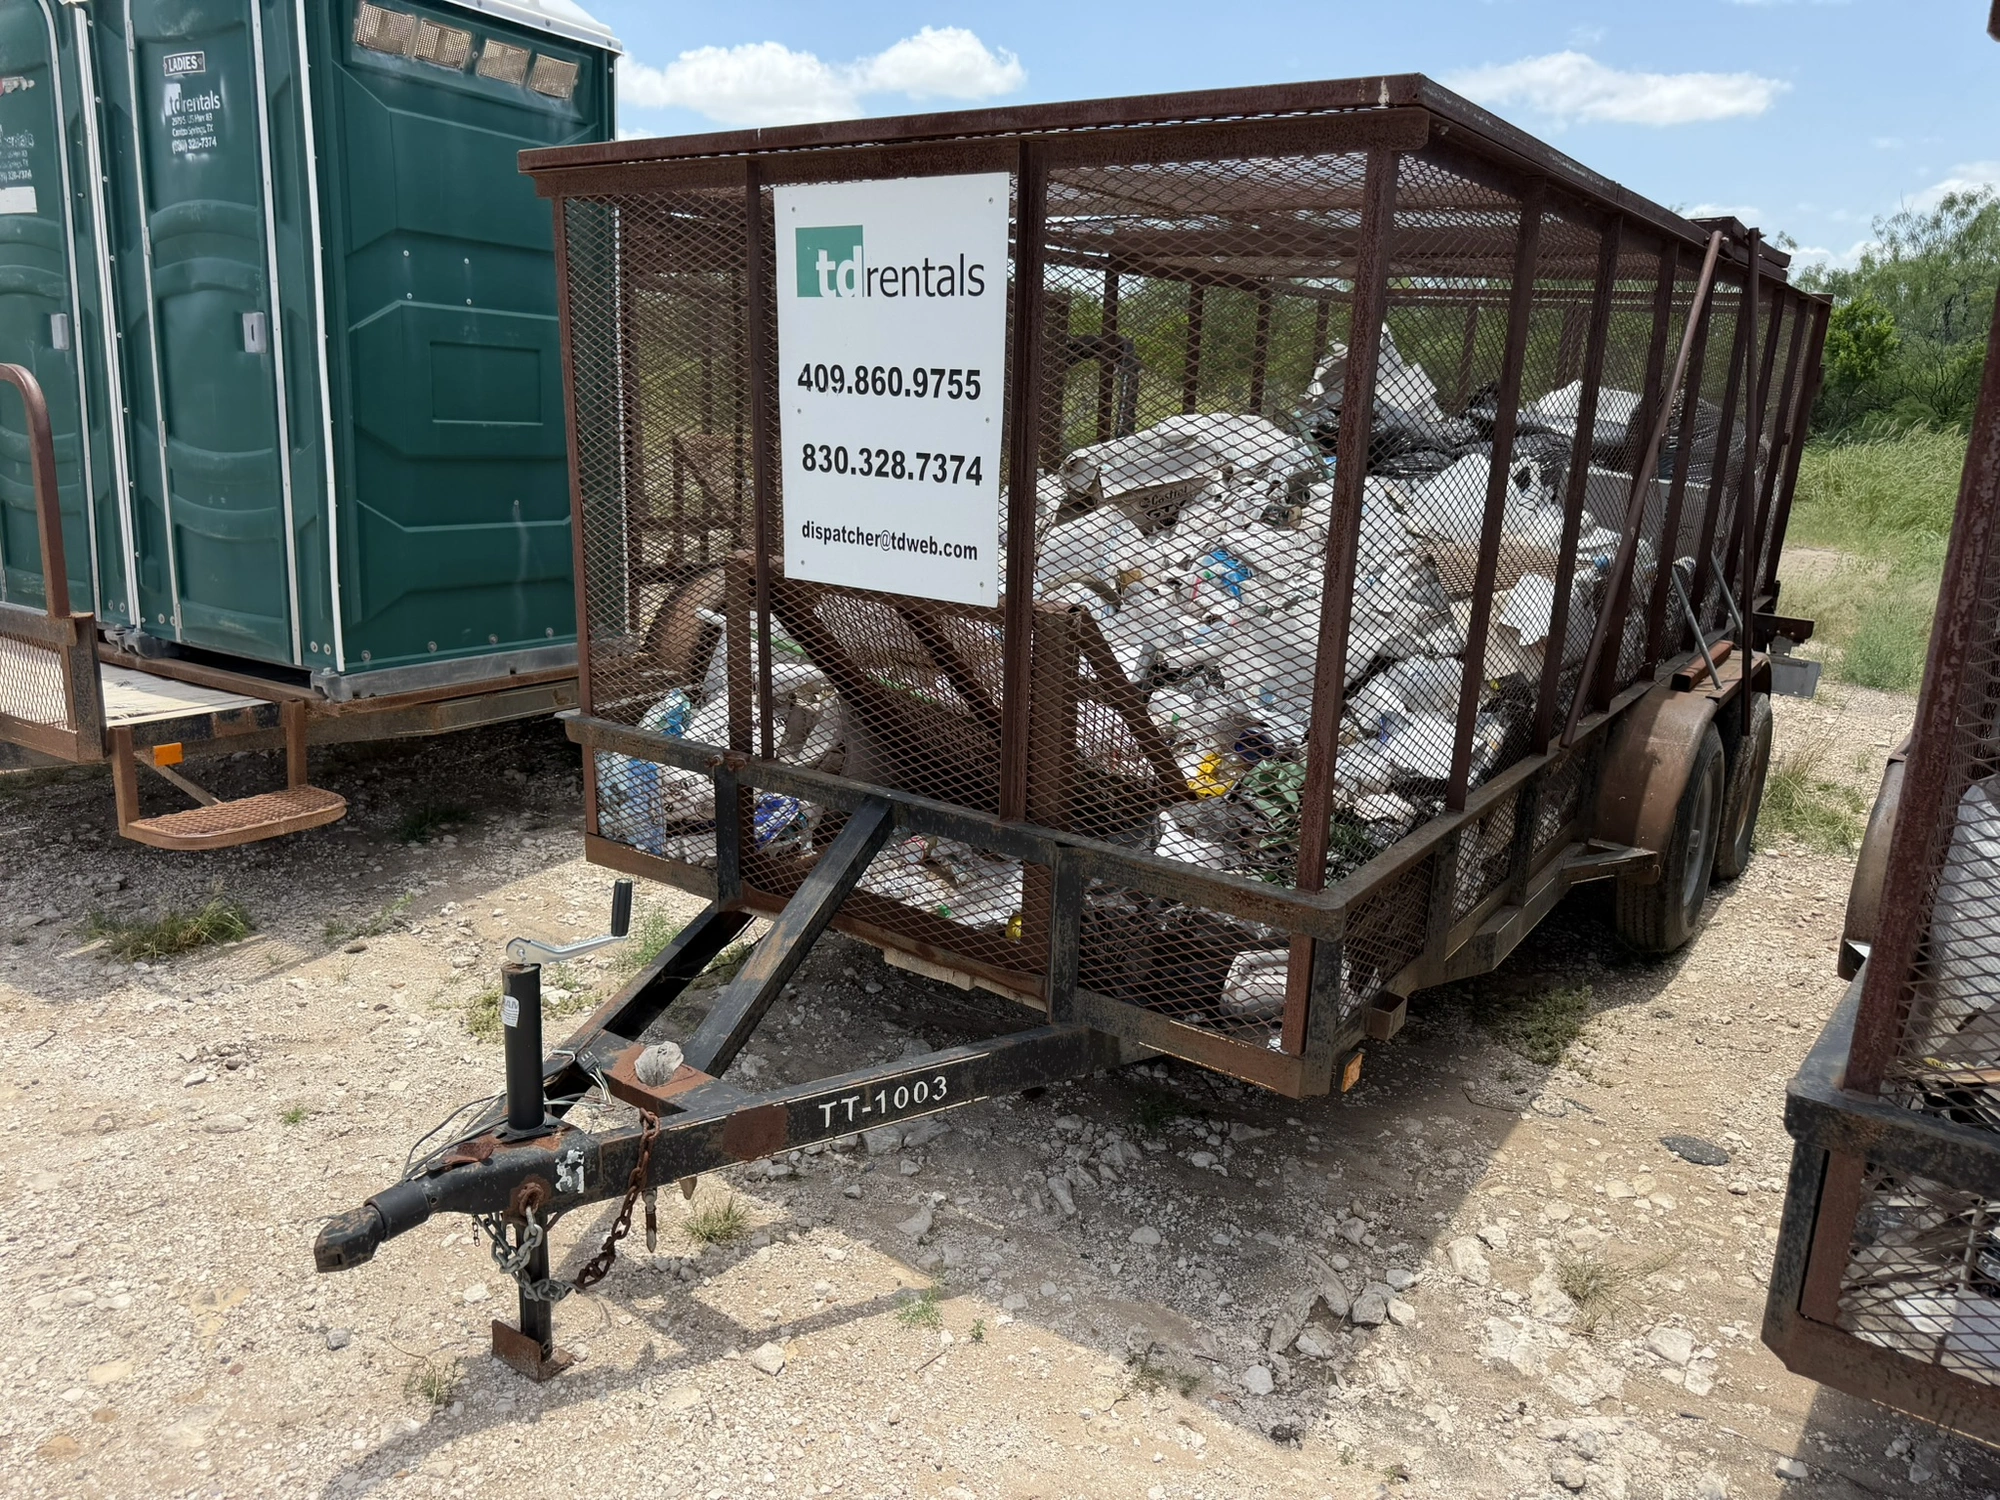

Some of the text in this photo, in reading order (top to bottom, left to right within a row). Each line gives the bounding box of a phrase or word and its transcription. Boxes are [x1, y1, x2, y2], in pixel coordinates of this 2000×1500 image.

[168, 54, 198, 72] LADIES
[797, 363, 981, 400] 409.860.9755
[802, 443, 982, 486] 830.328.7374
[802, 520, 978, 560] dispatcher@tdweb.com
[818, 1075, 947, 1128] TT-1003
